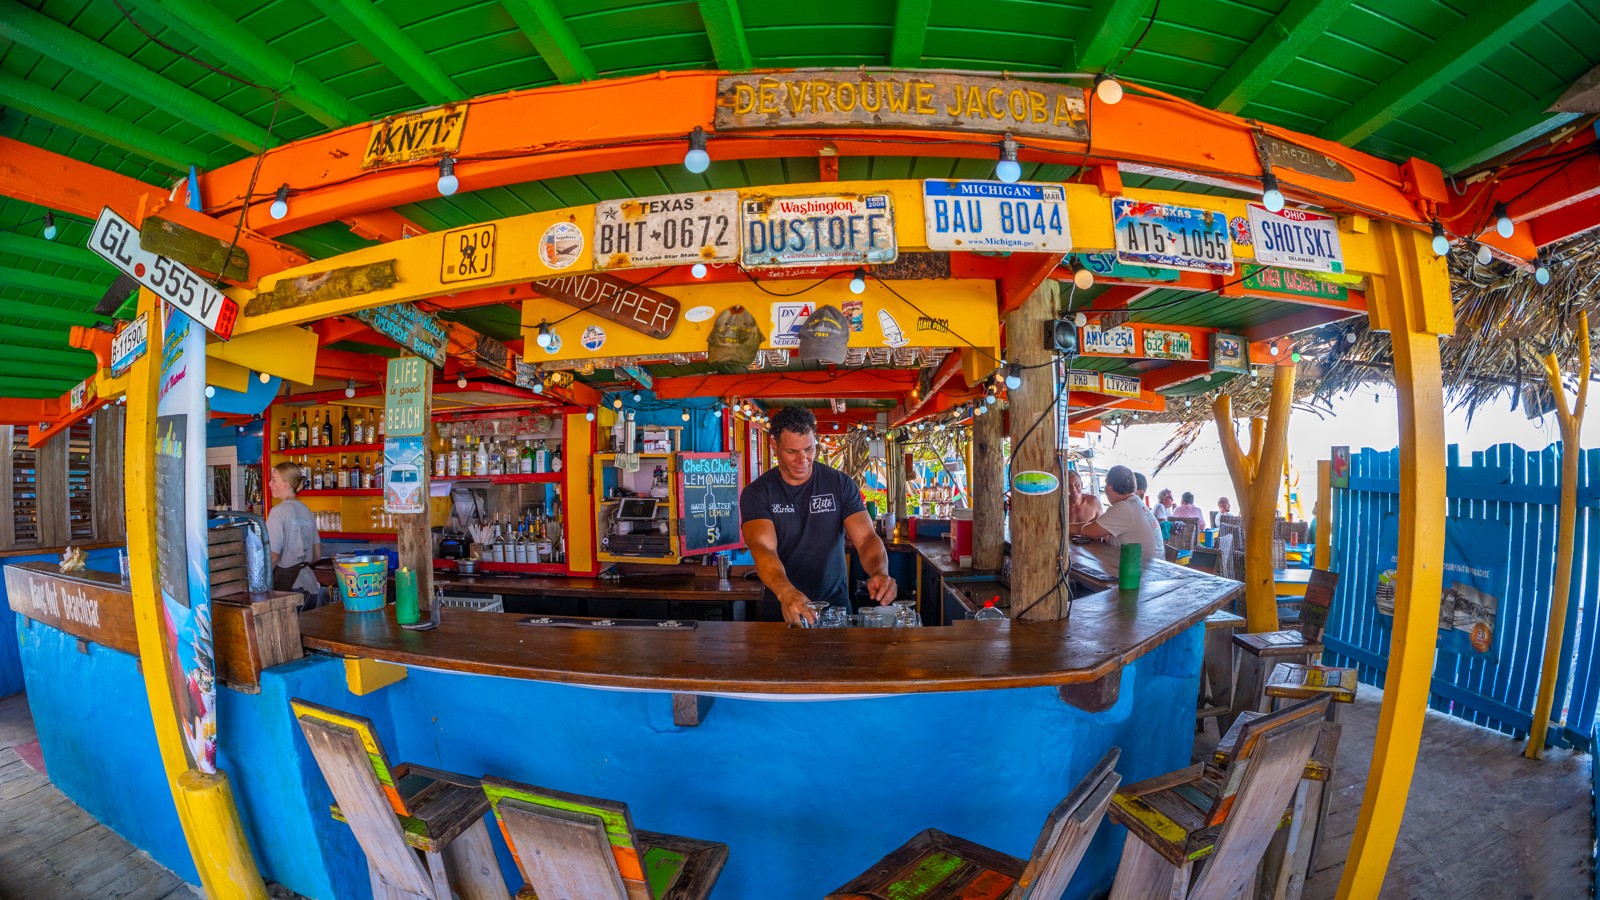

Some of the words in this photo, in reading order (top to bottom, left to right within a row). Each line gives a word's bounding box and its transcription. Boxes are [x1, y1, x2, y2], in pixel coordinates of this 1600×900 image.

[733, 82, 781, 116] DE
[785, 80, 938, 117] VROUWE
[945, 83, 1077, 128] JACOBA
[367, 111, 463, 158] AKN717
[961, 184, 1031, 197] MICHIGAN
[1044, 192, 1061, 200] MAR
[639, 197, 694, 215] TEXAS
[780, 200, 856, 215] Washington
[1152, 206, 1192, 219] TEXAS
[934, 199, 983, 233] BAU
[1000, 201, 1063, 236] 8044
[1162, 215, 1185, 224] TRUCK
[1283, 210, 1307, 221] OHIO
[600, 220, 648, 255] BHT
[663, 214, 729, 250] 0672
[750, 213, 885, 254] DUSTOFF
[1262, 220, 1336, 260] SHOTSKI
[99, 217, 133, 267] GL
[968, 237, 1034, 247] www.Michigan.gov
[1127, 221, 1165, 253] AT5
[1179, 227, 1227, 262] 1055
[781, 252, 819, 260] Centennial
[1287, 255, 1316, 264] DELAWARE
[150, 256, 199, 307] 555
[200, 286, 218, 319] V
[781, 308, 797, 319] DN
[1115, 331, 1133, 347] 254
[1146, 337, 1163, 352] 632
[1172, 338, 1189, 354] HMM
[394, 360, 418, 384] LIFE
[1074, 374, 1088, 386] PKB
[389, 385, 397, 395] is
[399, 383, 421, 398] good
[387, 406, 420, 431] BEACH
[684, 473, 737, 486] LEMONADE
[811, 497, 833, 510] Elite
[708, 510, 731, 518] LEMON
